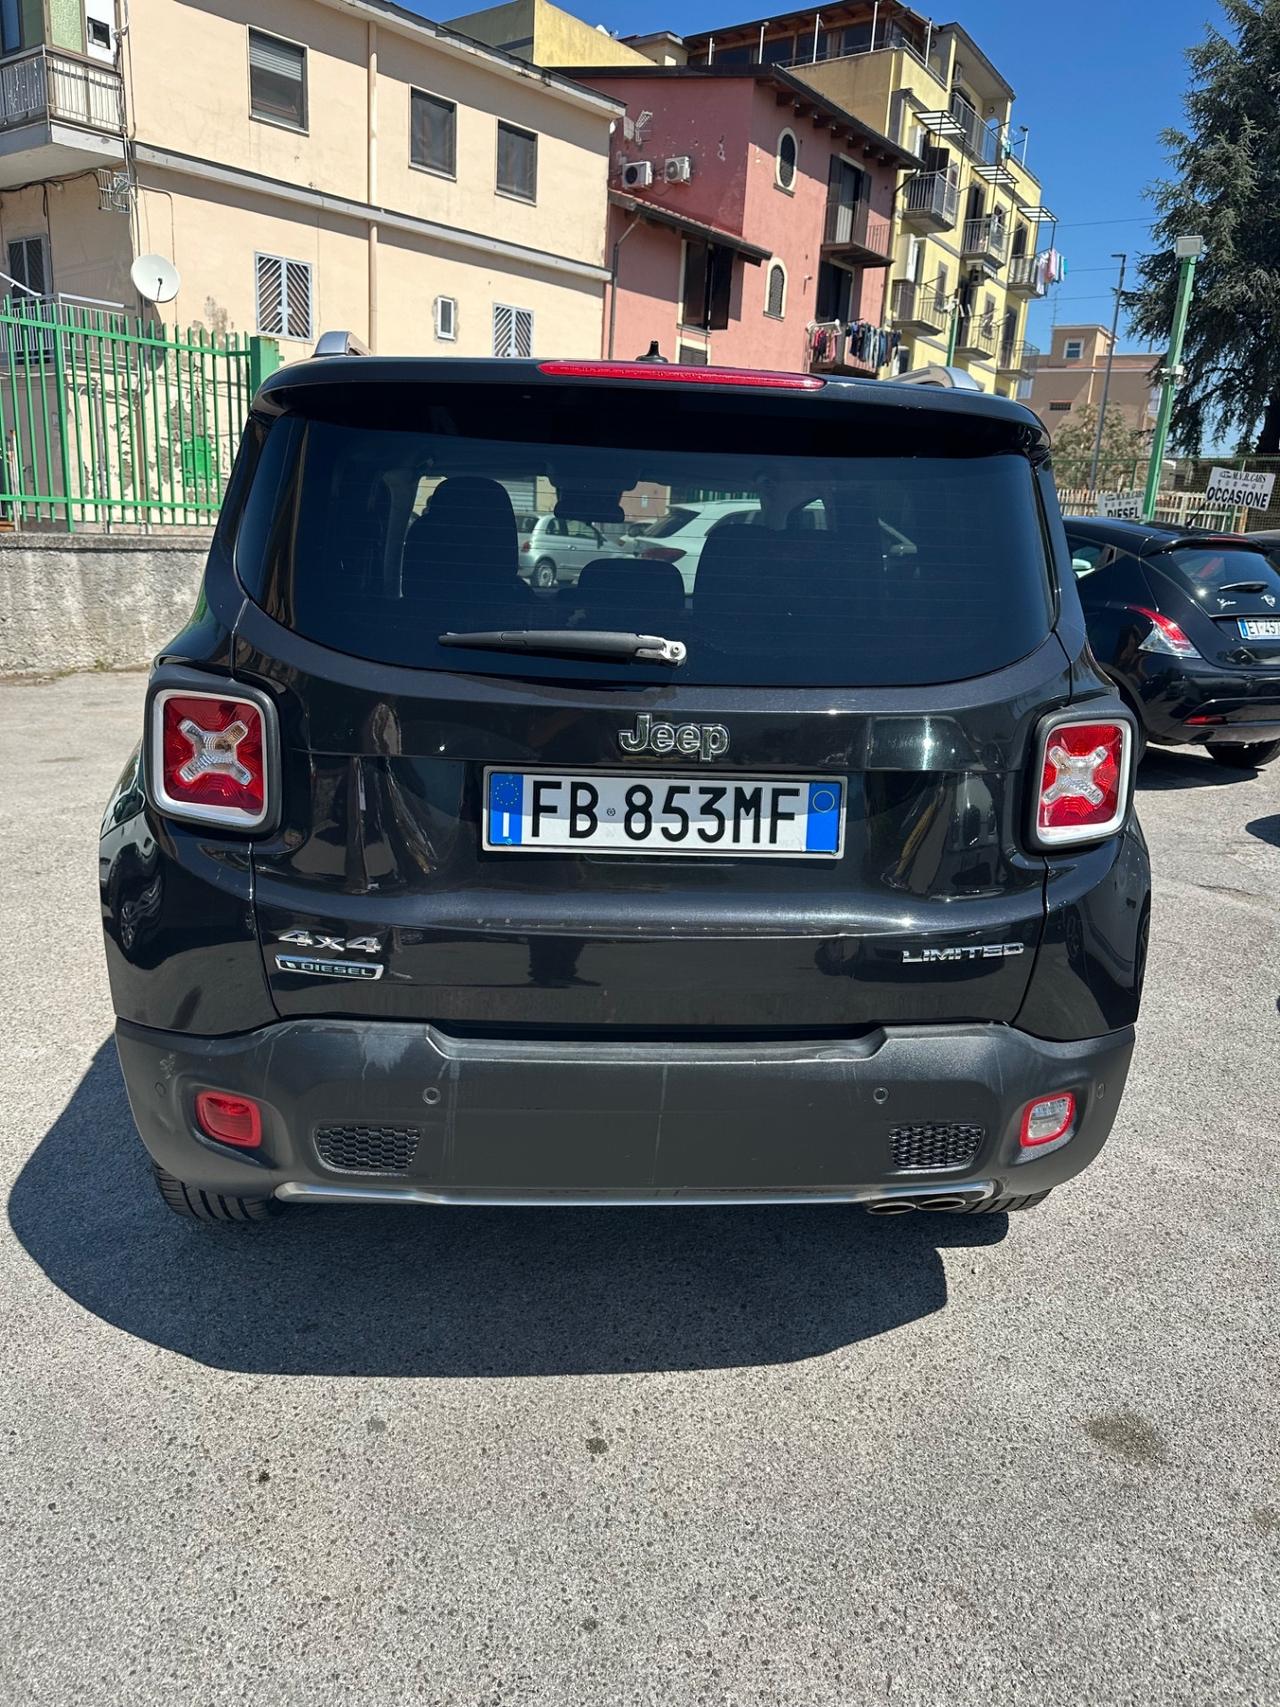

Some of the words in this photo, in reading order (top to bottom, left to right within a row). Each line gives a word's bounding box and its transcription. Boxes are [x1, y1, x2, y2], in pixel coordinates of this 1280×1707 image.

[1207, 486, 1269, 508] OCCASIONE
[1107, 506, 1140, 518] DIESEL
[618, 712, 730, 762] Jeep
[531, 780, 599, 839] FB
[623, 784, 801, 844] 853MF
[902, 942, 1025, 963] LIMITED
[301, 962, 373, 976] DIESEL
